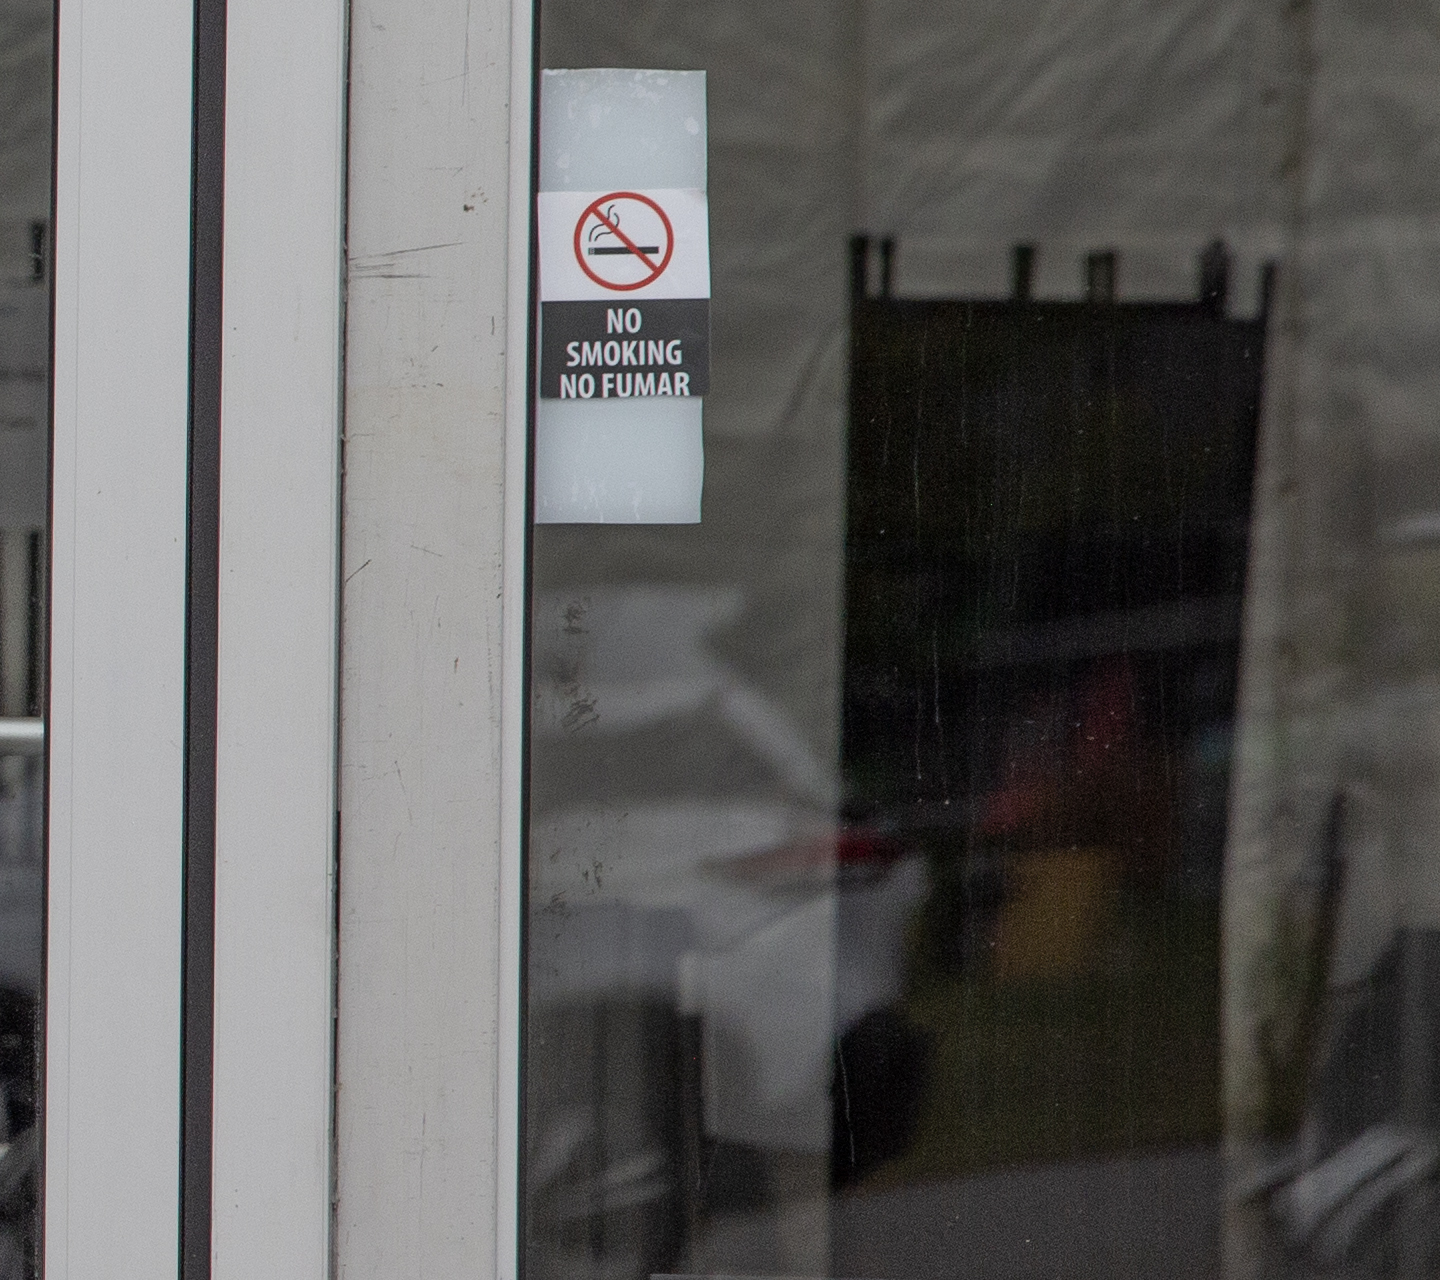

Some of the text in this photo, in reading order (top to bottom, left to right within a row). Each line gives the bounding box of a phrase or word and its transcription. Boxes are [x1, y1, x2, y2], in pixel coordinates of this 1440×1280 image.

[607, 308, 642, 334] NO
[566, 339, 682, 367] SMOKING
[560, 371, 690, 399] NO FUMAR
